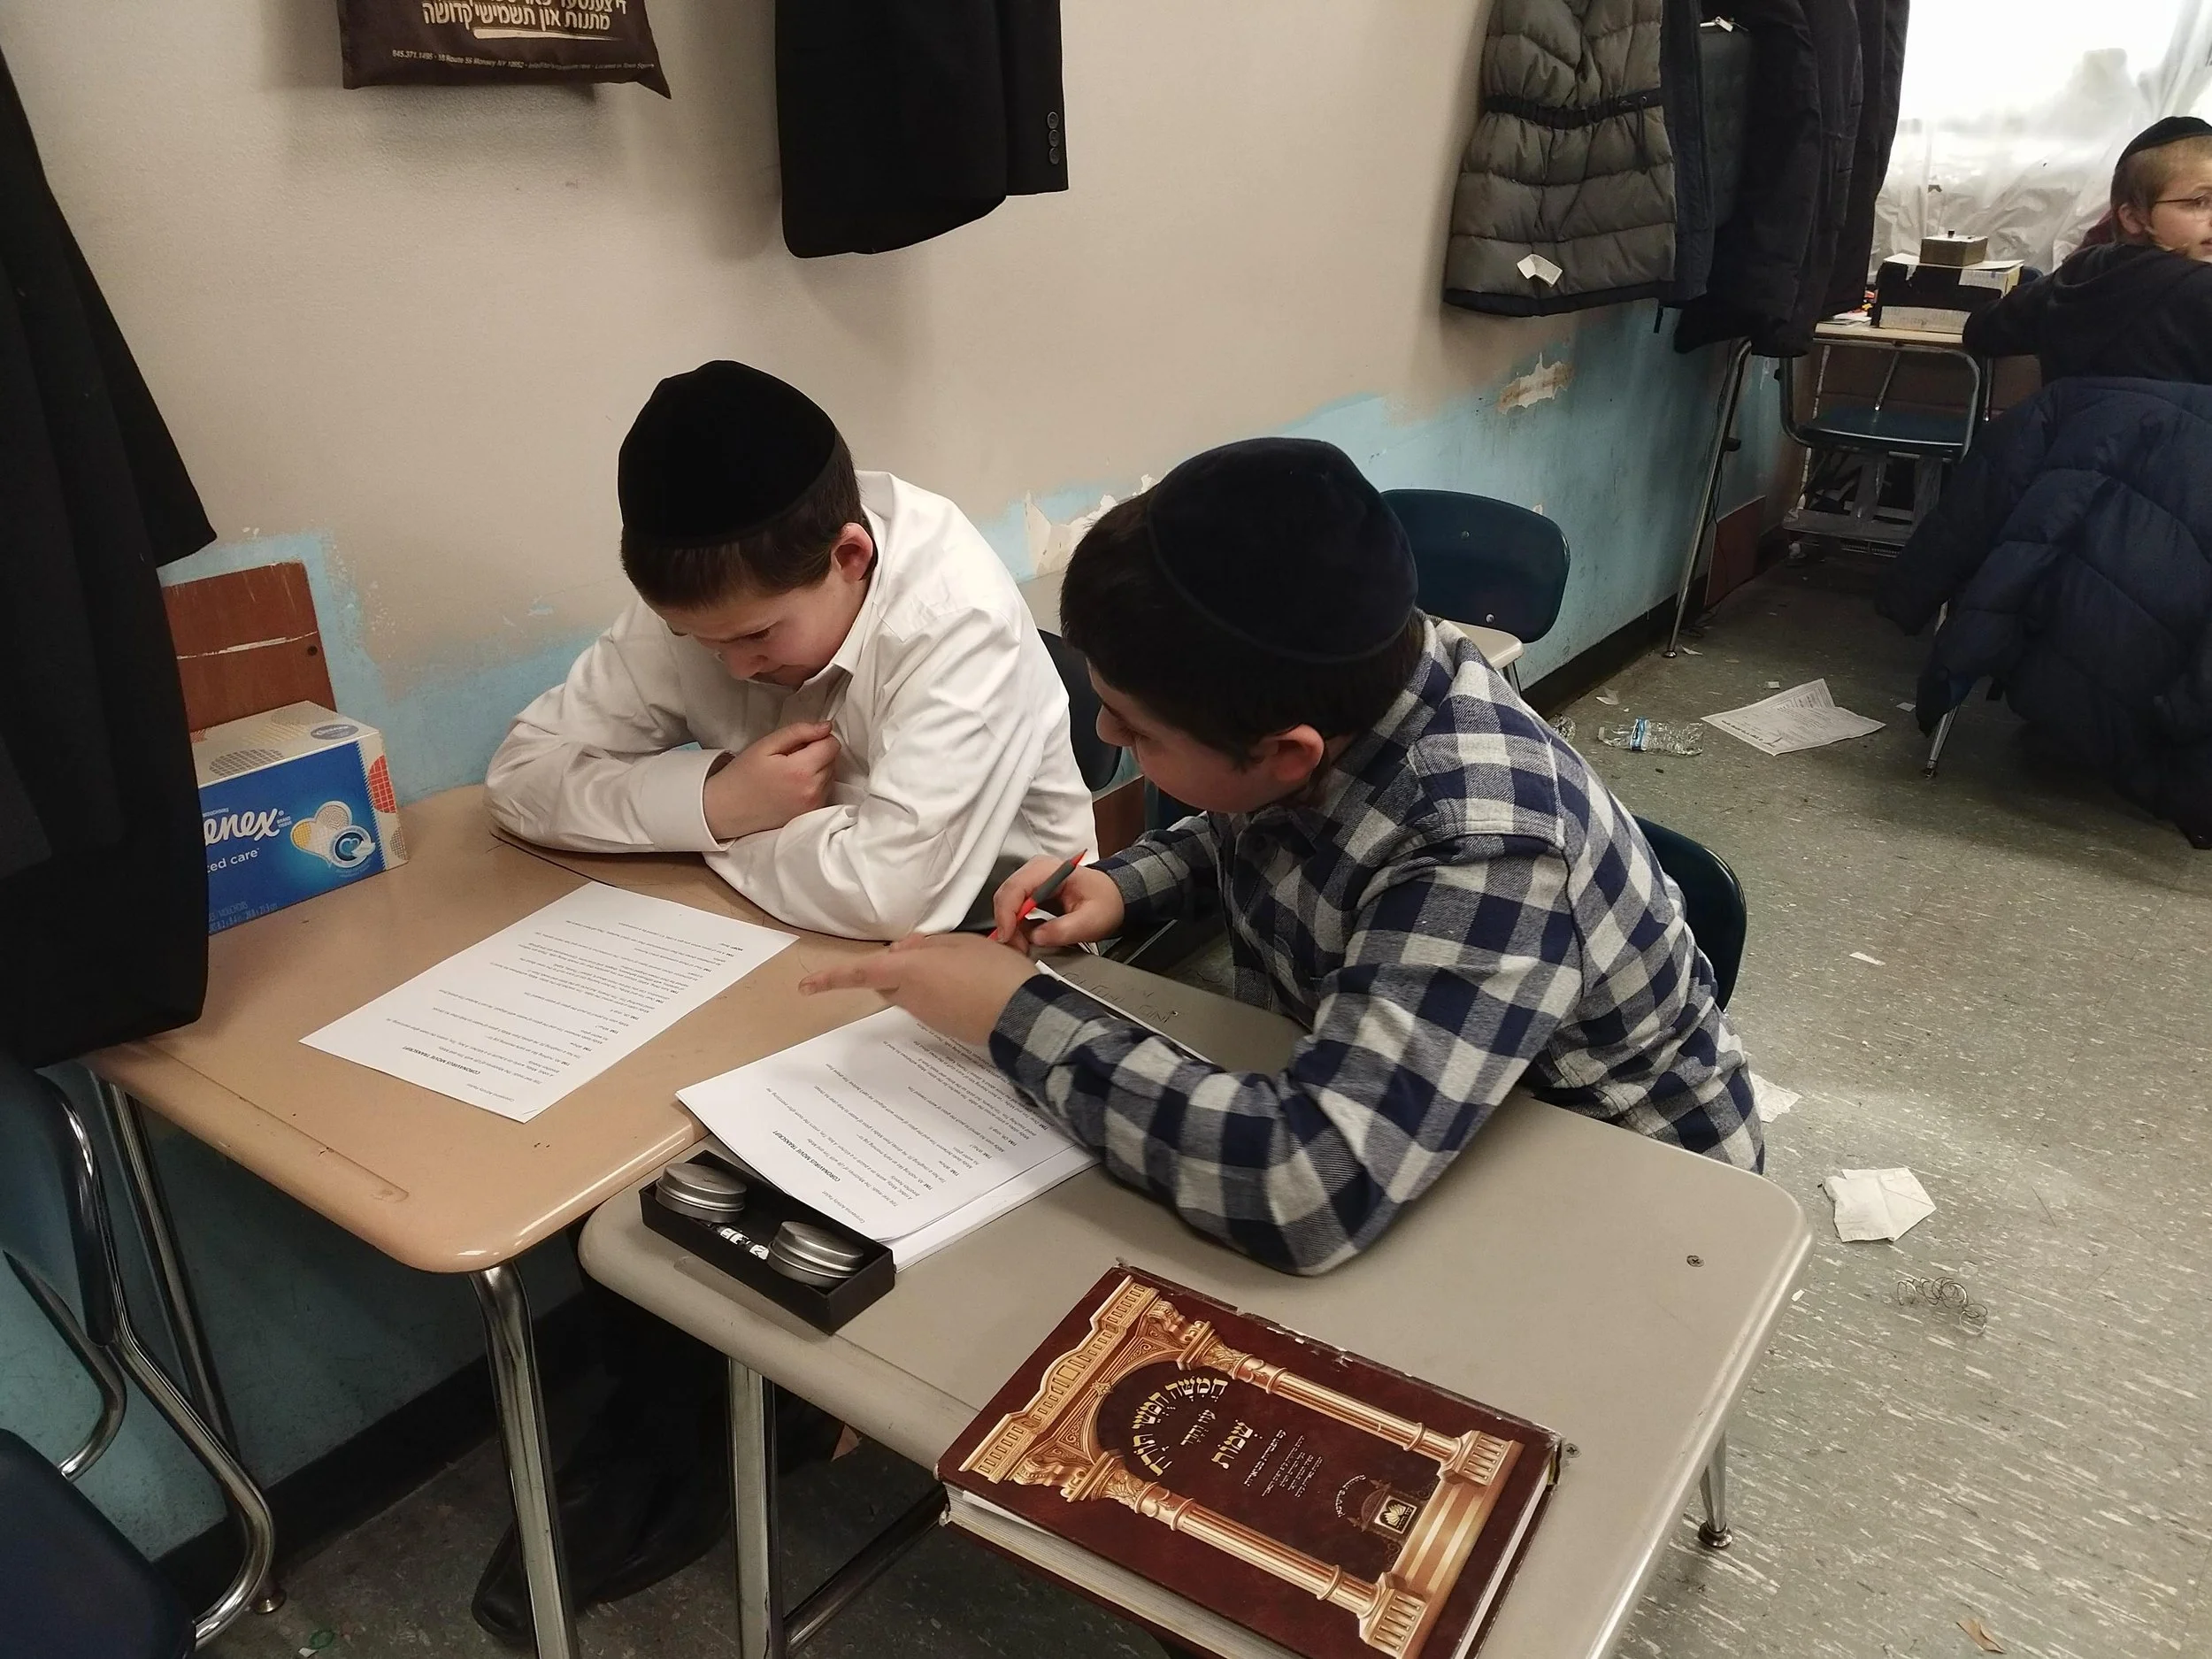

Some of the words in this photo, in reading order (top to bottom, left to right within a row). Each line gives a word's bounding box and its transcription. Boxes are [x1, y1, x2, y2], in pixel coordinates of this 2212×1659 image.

[422, 2, 472, 29] קדושה
[475, 5, 535, 26] תשמישי
[540, 8, 561, 31] און
[565, 12, 611, 30] מתנות
[204, 808, 280, 847] enex
[230, 849, 258, 864] care
[401, 1045, 432, 1057] TRANSCRIPT
[444, 1061, 480, 1075] CORONAVIRUS
[772, 1130, 798, 1149] TRANSCRIPT
[795, 1148, 812, 1160] MOVIE
[809, 1158, 841, 1182] CORONAVIRUS
